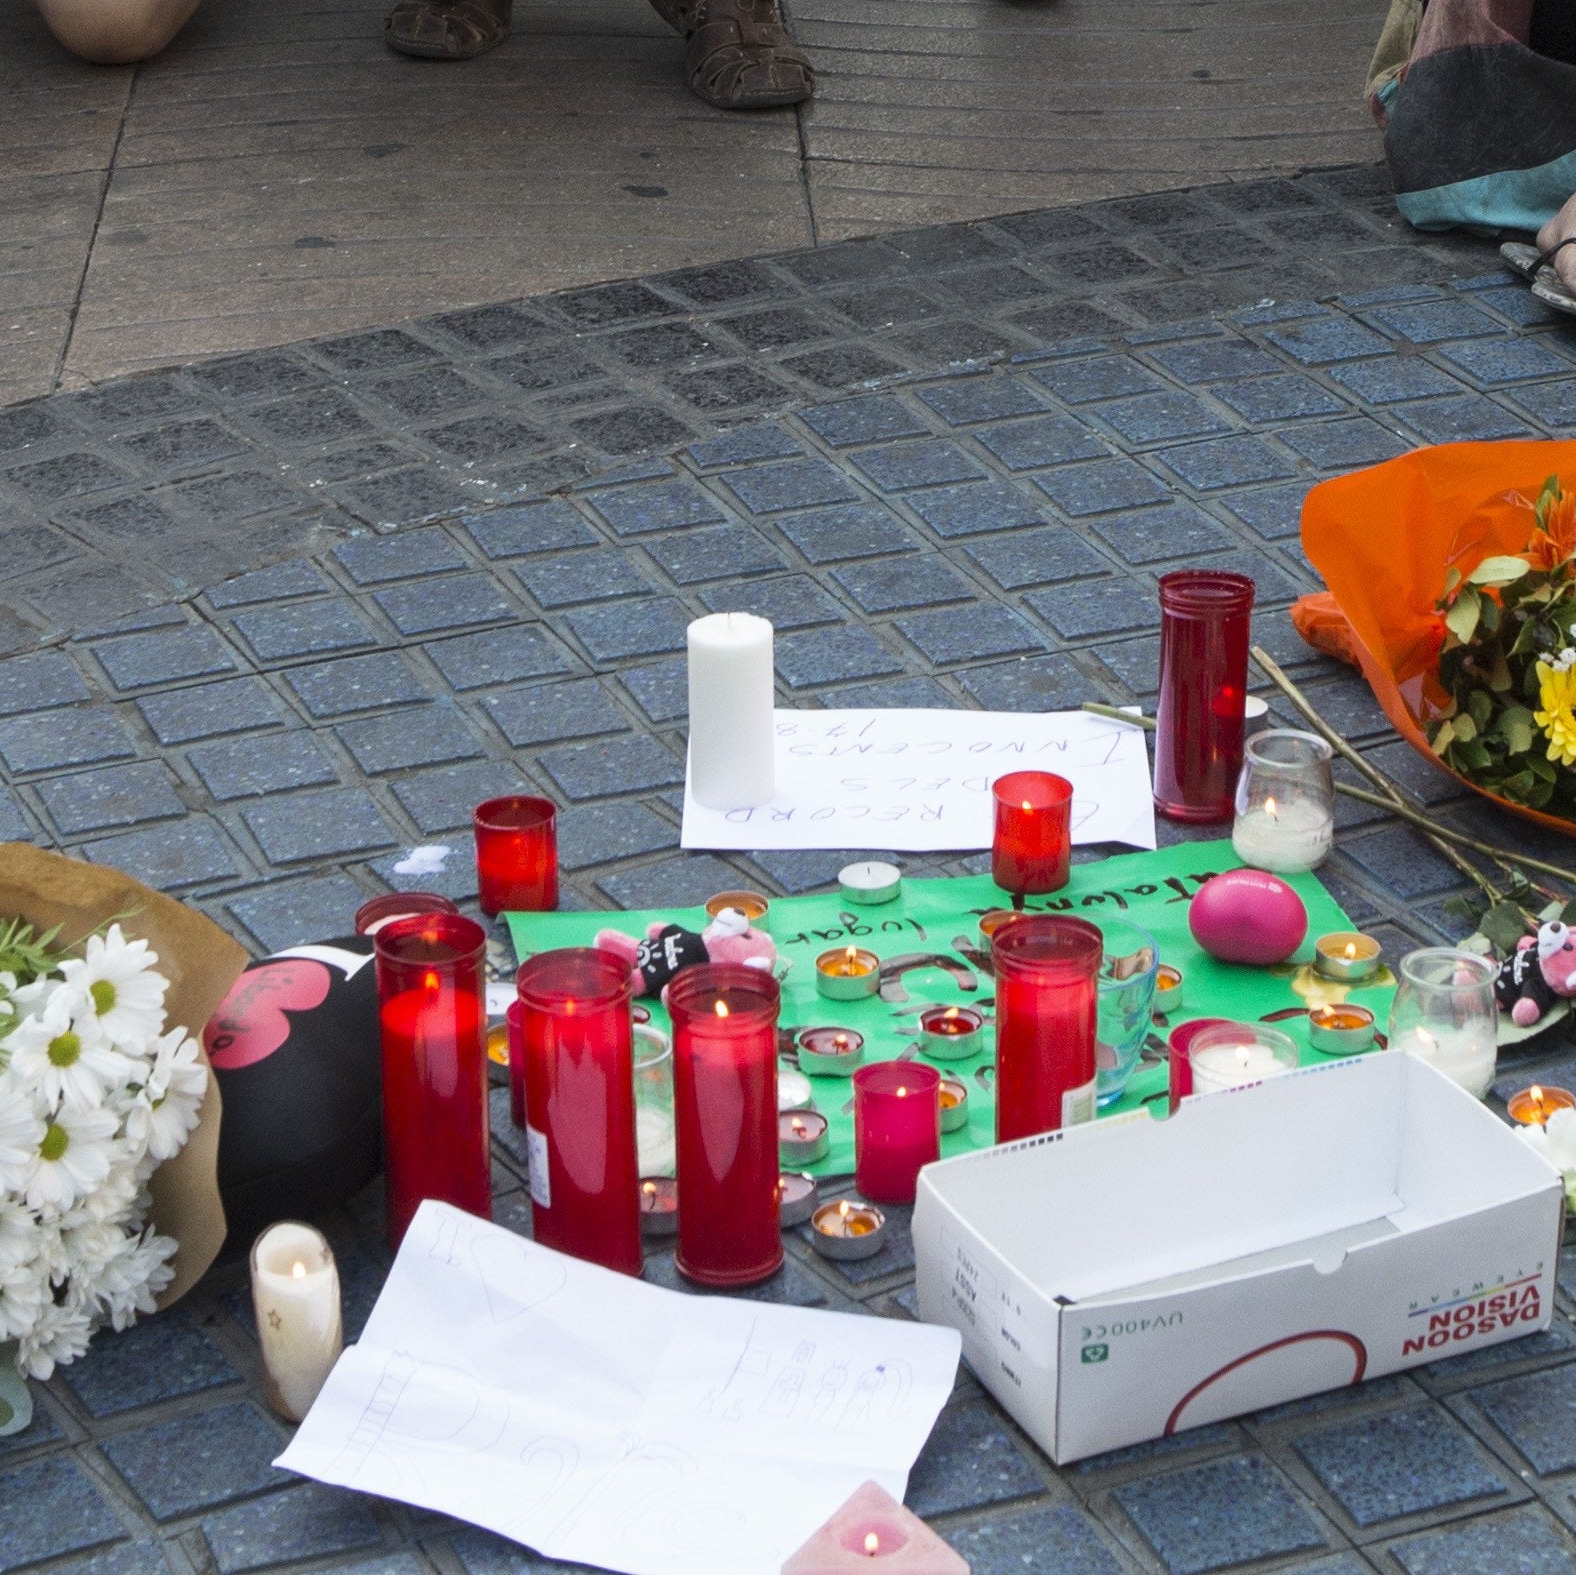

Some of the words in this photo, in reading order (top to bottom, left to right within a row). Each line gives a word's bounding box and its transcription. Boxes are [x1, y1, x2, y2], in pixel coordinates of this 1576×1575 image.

[840, 776, 991, 793] DELS
[724, 804, 944, 824] RECORD
[784, 911, 928, 945] lugar
[1428, 1284, 1541, 1332] VISION
[1401, 1300, 1541, 1357] DASOON
